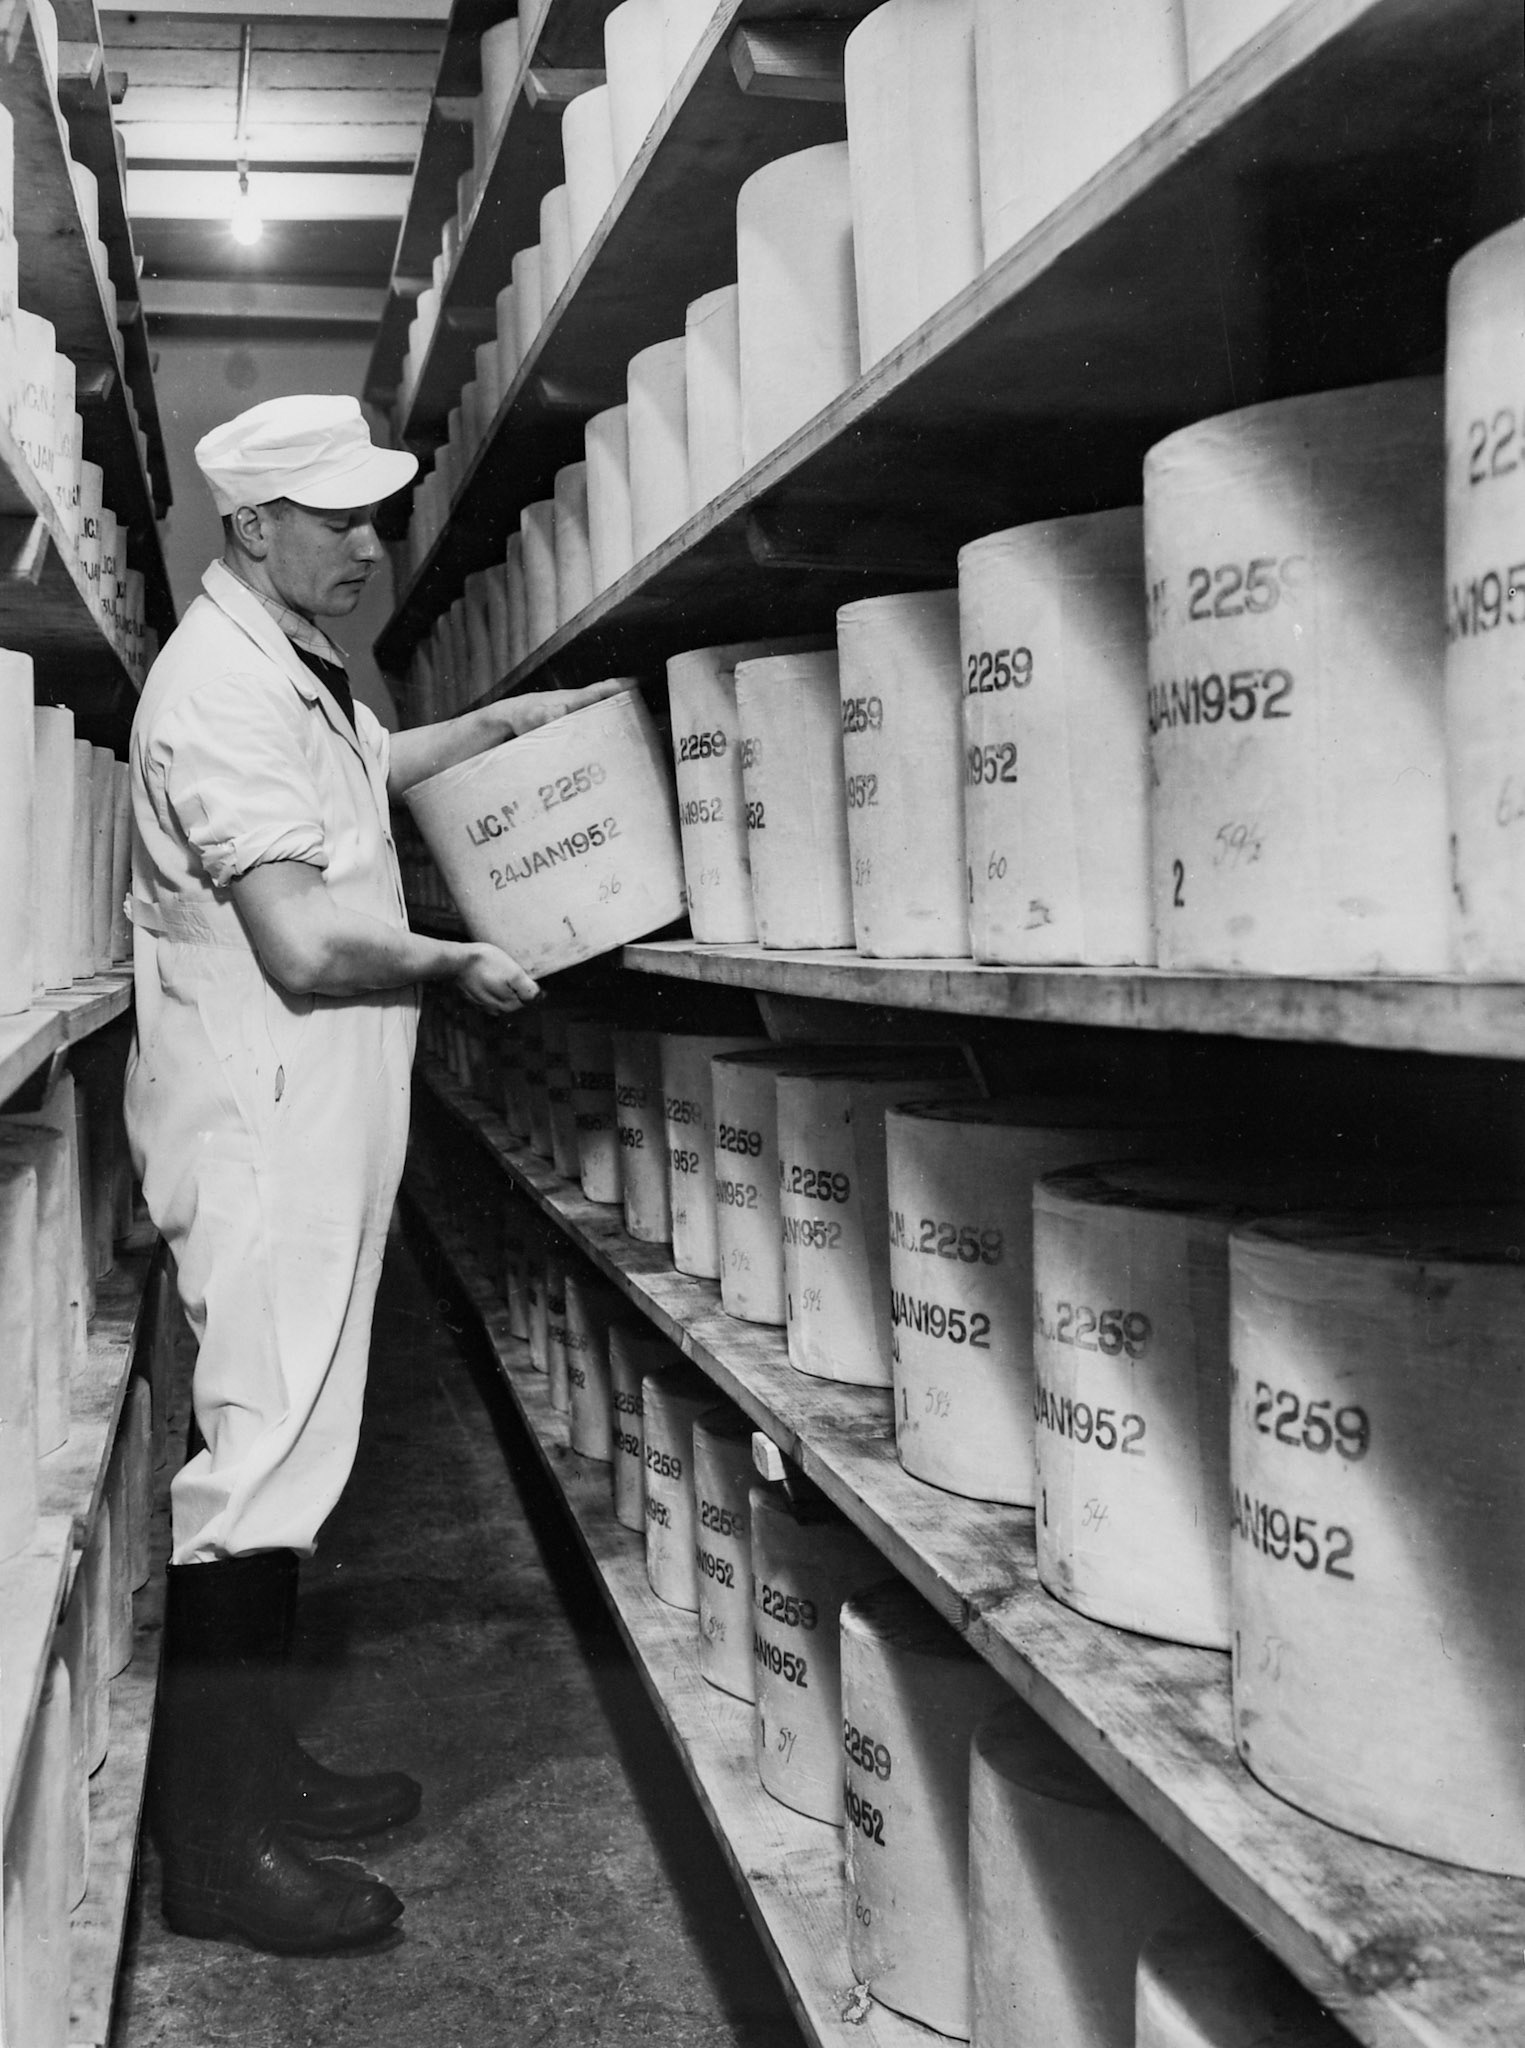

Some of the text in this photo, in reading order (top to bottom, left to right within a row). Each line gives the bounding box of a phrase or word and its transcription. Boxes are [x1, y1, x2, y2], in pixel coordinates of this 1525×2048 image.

[1468, 408, 1525, 484] 22
[967, 646, 1033, 694] 2259
[537, 762, 607, 812] 2259
[489, 816, 622, 891] 24JAN1952
[719, 1123, 762, 1157] 2259
[791, 1164, 851, 1203] 2259
[1256, 1380, 1371, 1463] 2259
[702, 1500, 745, 1537] 2259
[762, 1585, 818, 1631] 2259
